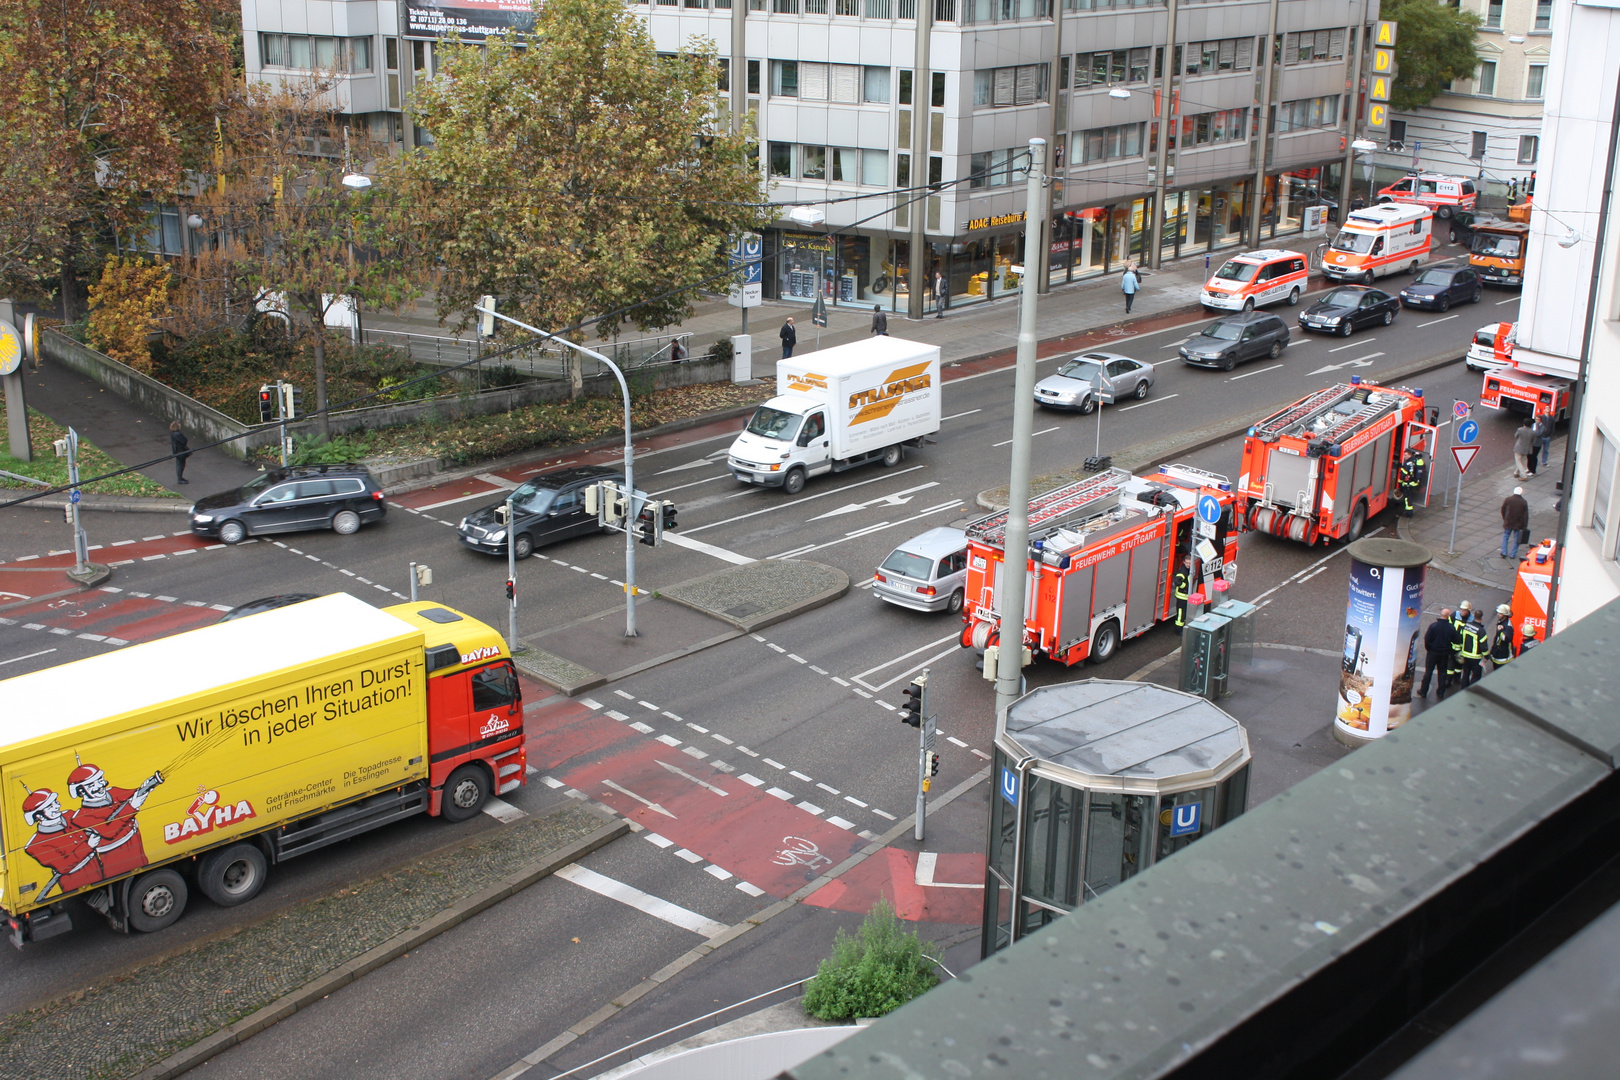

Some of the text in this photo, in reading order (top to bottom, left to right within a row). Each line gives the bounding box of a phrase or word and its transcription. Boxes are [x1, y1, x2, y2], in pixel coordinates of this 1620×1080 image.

[409, 8, 428, 16] Tickets
[418, 16, 437, 24] (0711)
[1371, 23, 1391, 125] ADAC
[969, 217, 988, 230] ADAC
[849, 373, 931, 409] STRASSNER
[1500, 385, 1538, 400] FEUERWEHR
[1343, 416, 1394, 454] FEUERWEHR STUTTGART
[1075, 529, 1157, 570] FEUERWEHR STUTTGART
[1210, 558, 1222, 571] 112
[1045, 592, 1056, 603] 112
[1524, 616, 1546, 628] FEUE
[461, 646, 500, 664] BAYHA
[176, 718, 213, 742] Wir
[219, 693, 299, 731] löschen
[305, 678, 354, 705] Ihren
[360, 659, 411, 689] Durst
[243, 679, 412, 746] in jeder Situation!
[480, 719, 510, 735] BAYHA
[343, 754, 402, 780] Die Topadresse
[343, 767, 390, 788] in Esslingen
[265, 778, 333, 805] Getränke-Center
[1004, 770, 1015, 795] U
[266, 785, 336, 814] und Frischmärkte
[163, 800, 256, 844] BAYHA
[1177, 805, 1197, 827] U
